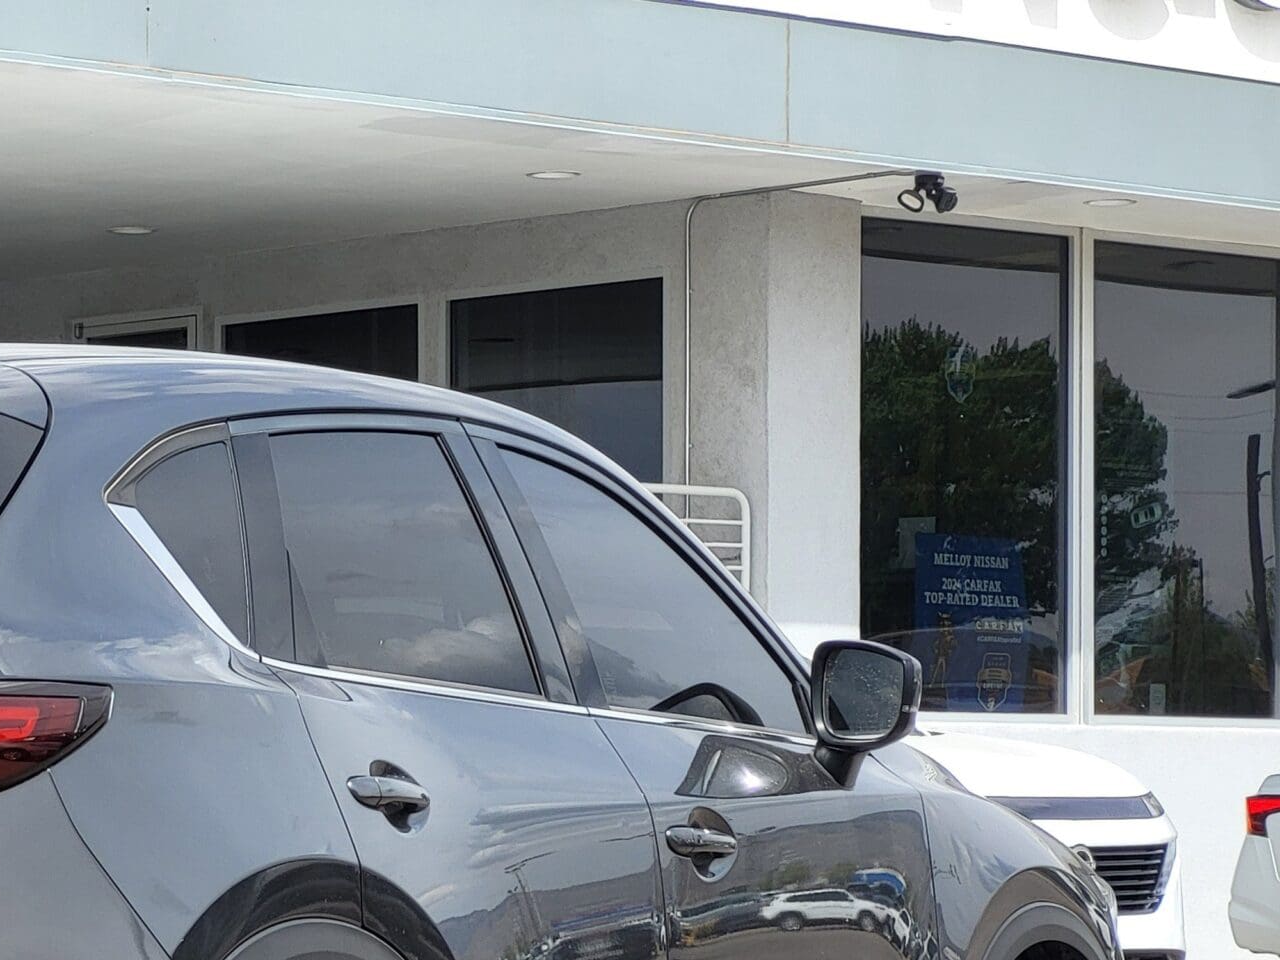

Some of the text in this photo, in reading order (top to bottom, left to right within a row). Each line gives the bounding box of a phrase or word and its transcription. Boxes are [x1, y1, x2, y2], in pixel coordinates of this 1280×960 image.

[934, 552, 1009, 569] MELLOY NISSAN
[942, 578, 1002, 593] 2024 CARFAX
[924, 592, 1020, 608] TOP-RATED DEALER
